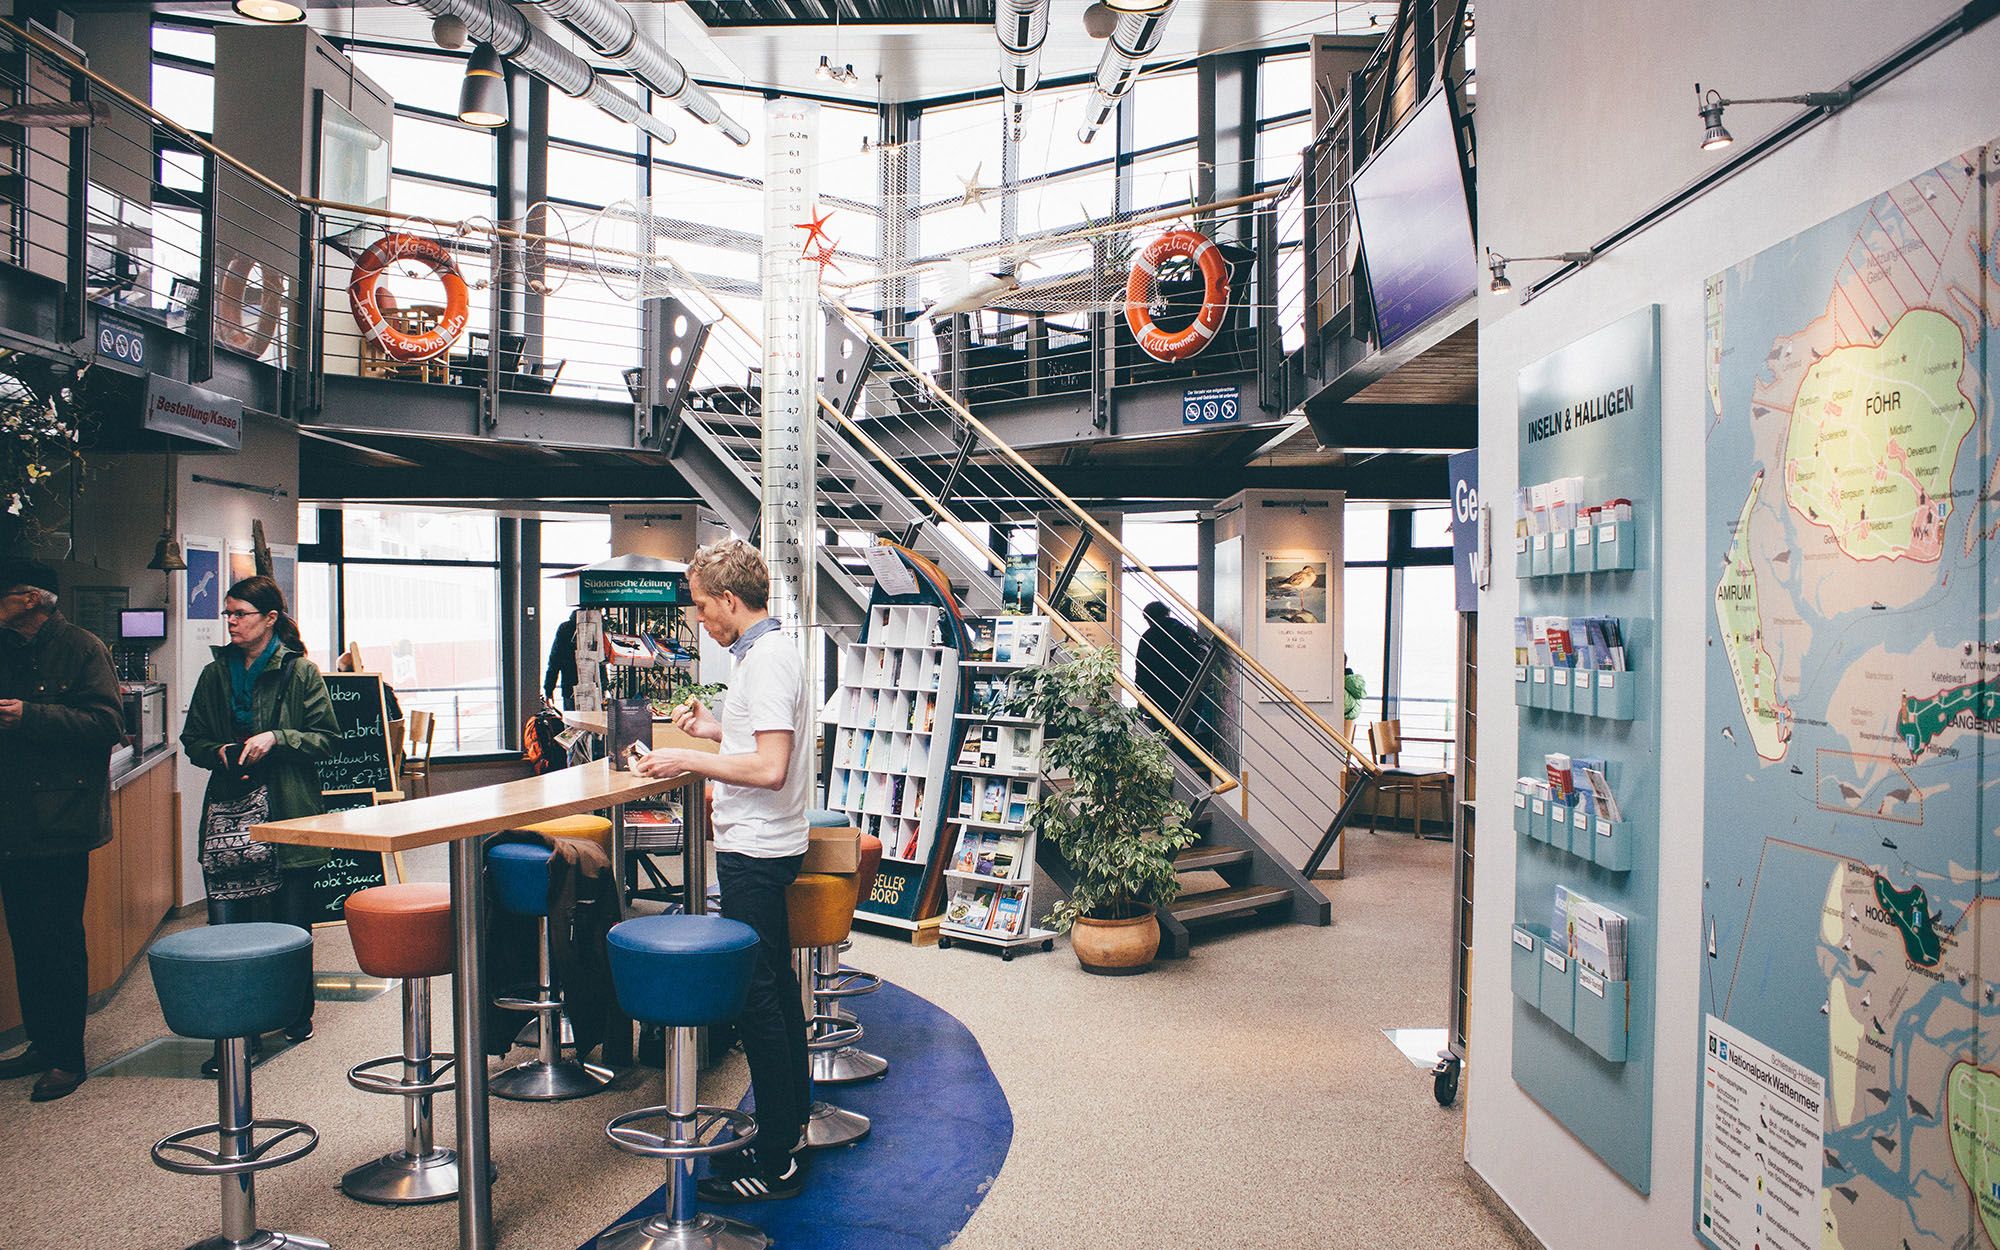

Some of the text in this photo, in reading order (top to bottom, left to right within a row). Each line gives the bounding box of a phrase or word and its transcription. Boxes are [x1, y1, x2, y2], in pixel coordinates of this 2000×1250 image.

[789, 241, 801, 249] 5,6
[788, 314, 800, 322] 5,2
[380, 331, 397, 347] zu
[399, 340, 422, 353] den
[787, 333, 799, 341] 5,1
[1143, 330, 1200, 352] Willkommen
[787, 351, 800, 359] 5,0
[787, 388, 800, 396] 4,8
[1865, 391, 1901, 417] FÖHR
[156, 395, 237, 430] Bestellung/Kasse
[1528, 384, 1634, 444] INSELN & HALLIGEN
[1889, 423, 1912, 436] Midlum
[786, 463, 799, 471] 4,4
[786, 482, 799, 490] 4,3
[786, 519, 798, 527] 4,1
[1912, 526, 1929, 541] Wyk
[786, 557, 799, 565] 3,9
[583, 578, 638, 589] Süddeutsche
[639, 577, 672, 590] Zeitung
[785, 575, 798, 583] 3,8
[786, 594, 798, 602] 3,7
[1717, 584, 1751, 601] AMRUM
[331, 684, 361, 701] bben
[869, 887, 899, 905] BORD
[1865, 1034, 1894, 1058] Norderoog
[1833, 1044, 1877, 1075] Norderoogsand
[1770, 1053, 1821, 1091] Schleswig-Holstein
